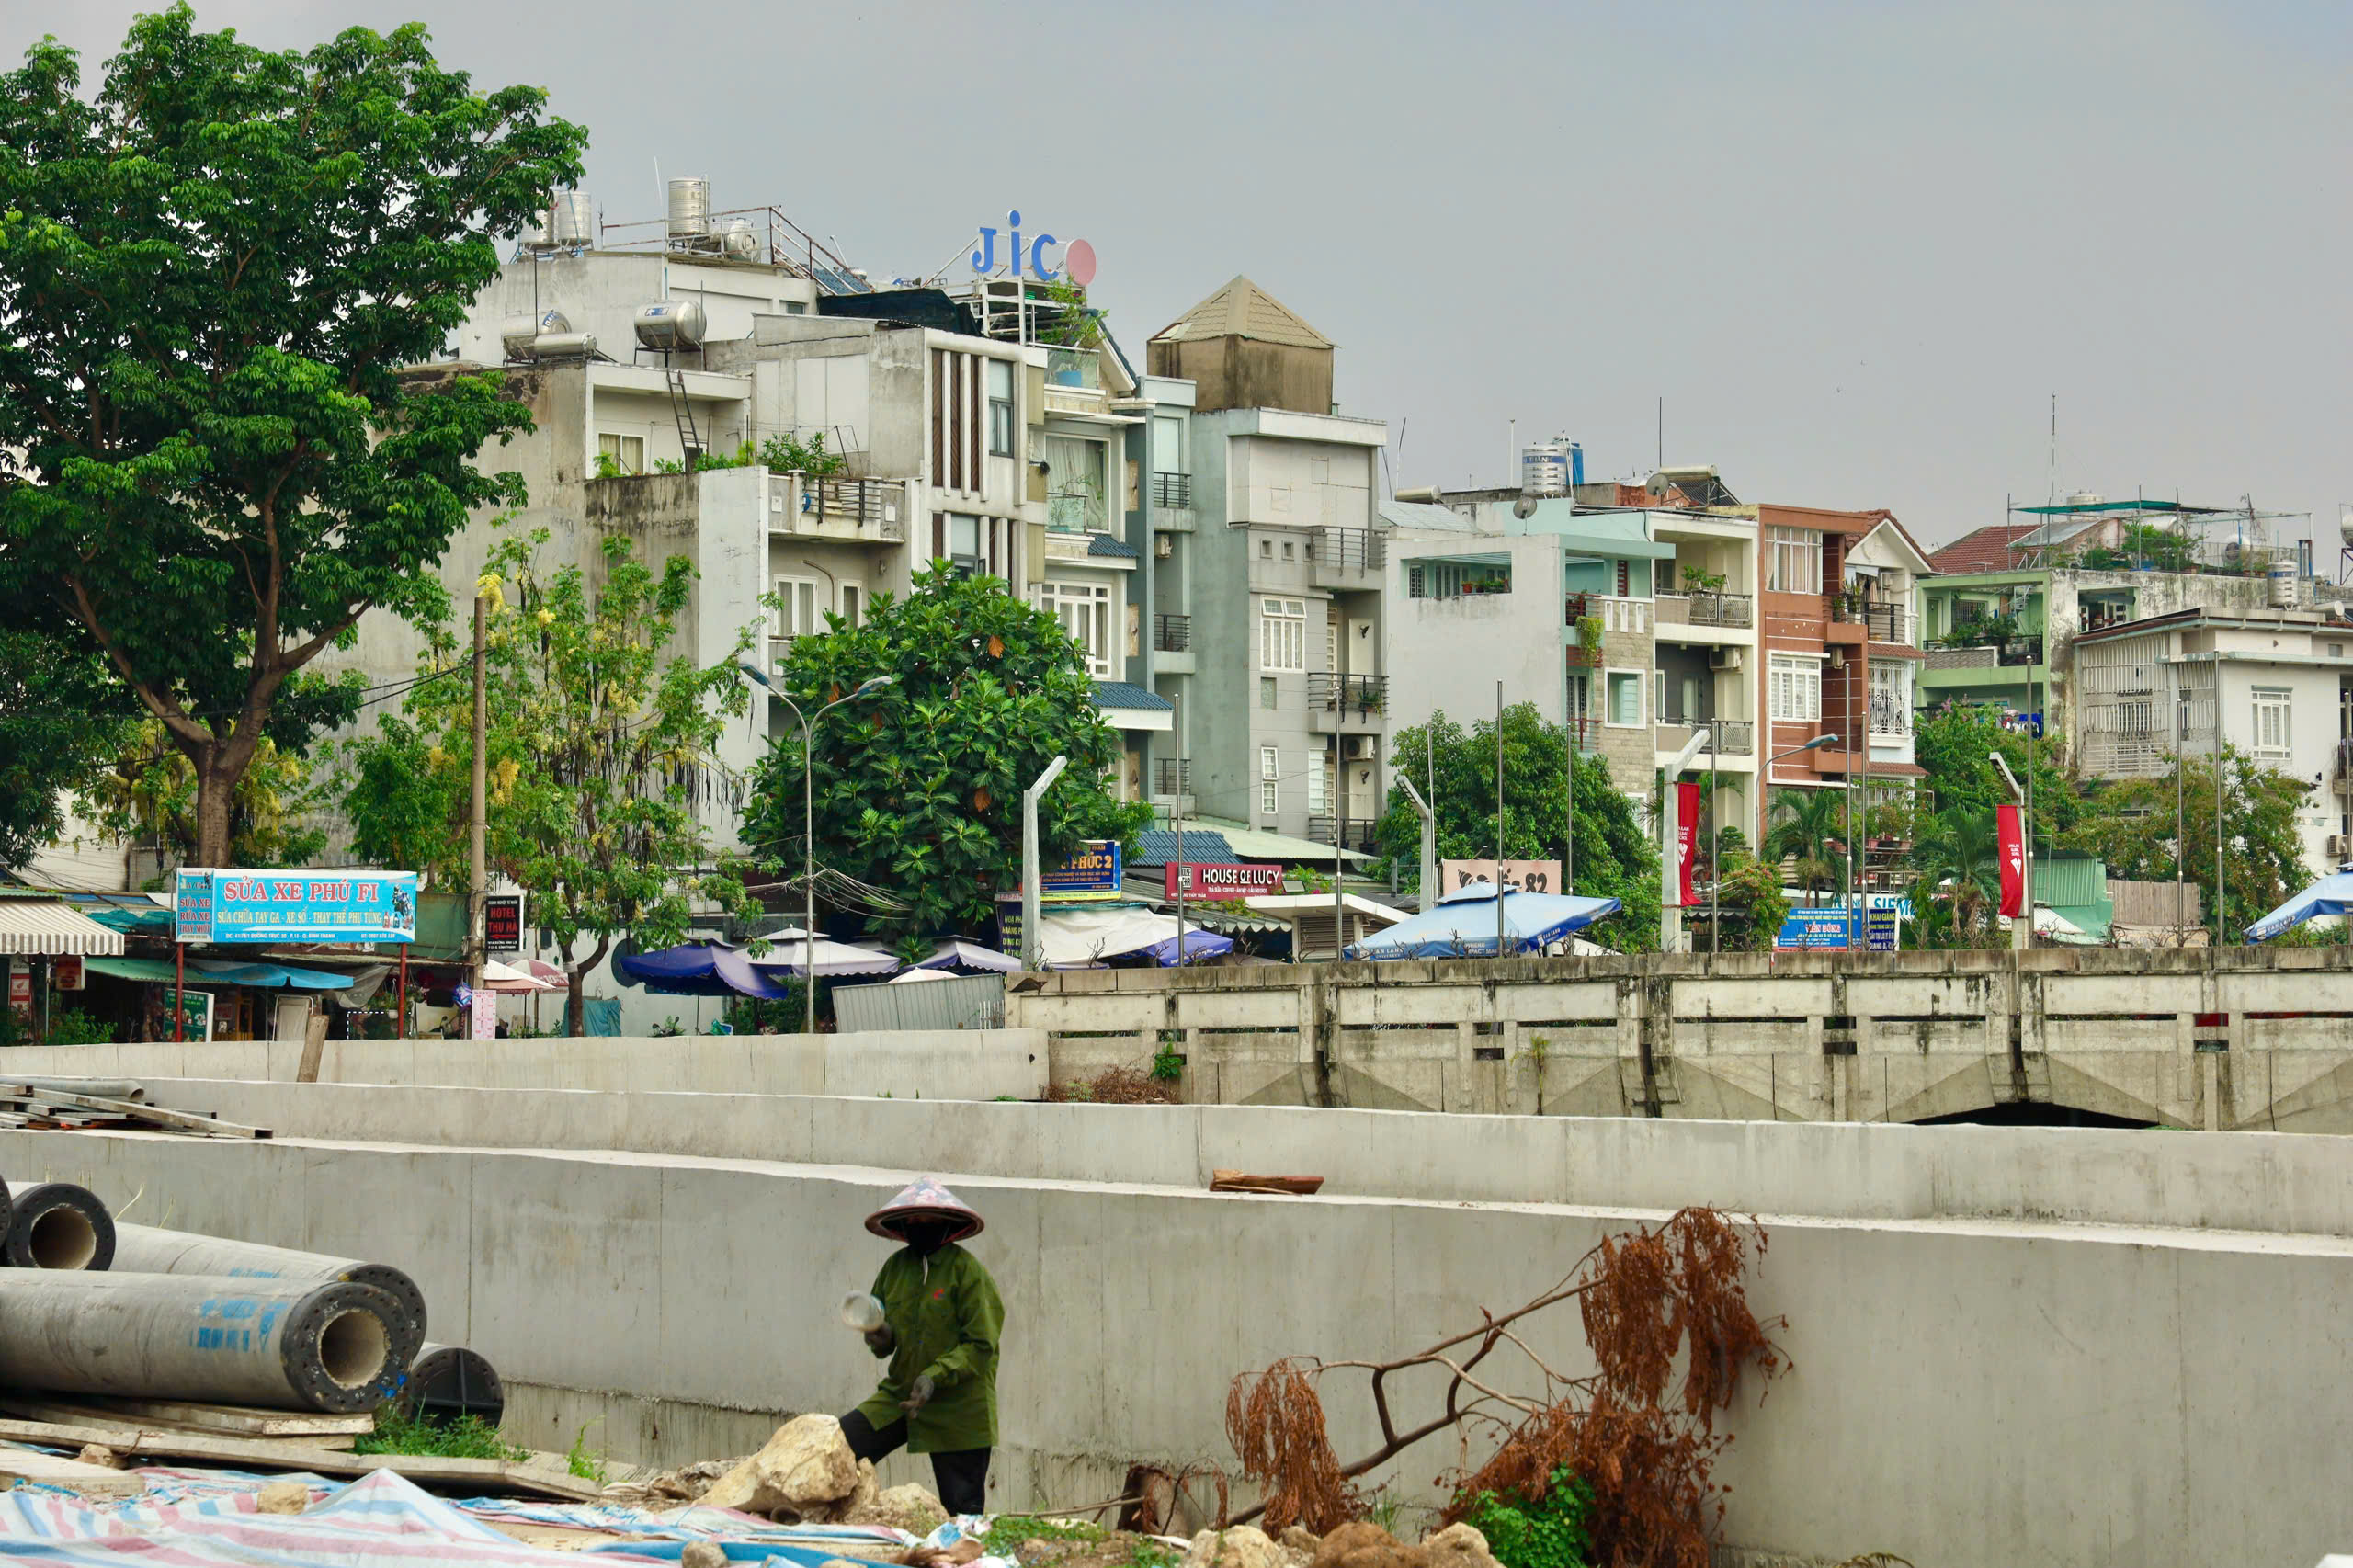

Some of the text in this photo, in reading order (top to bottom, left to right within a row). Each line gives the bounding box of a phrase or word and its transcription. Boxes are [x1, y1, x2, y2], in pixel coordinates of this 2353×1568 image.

[1104, 855, 1113, 869] 2
[1202, 869, 1237, 883] HOUSE
[1240, 870, 1251, 883] OF
[1253, 869, 1279, 884] LUCY
[224, 876, 268, 901] SỬA
[273, 882, 302, 901] XE
[310, 879, 350, 901] PHÚ
[358, 883, 379, 901] FI
[1525, 873, 1547, 893] 82
[199, 899, 210, 907] XE
[199, 912, 210, 920] XE
[490, 908, 516, 918] HOTEL
[488, 922, 503, 933] THU
